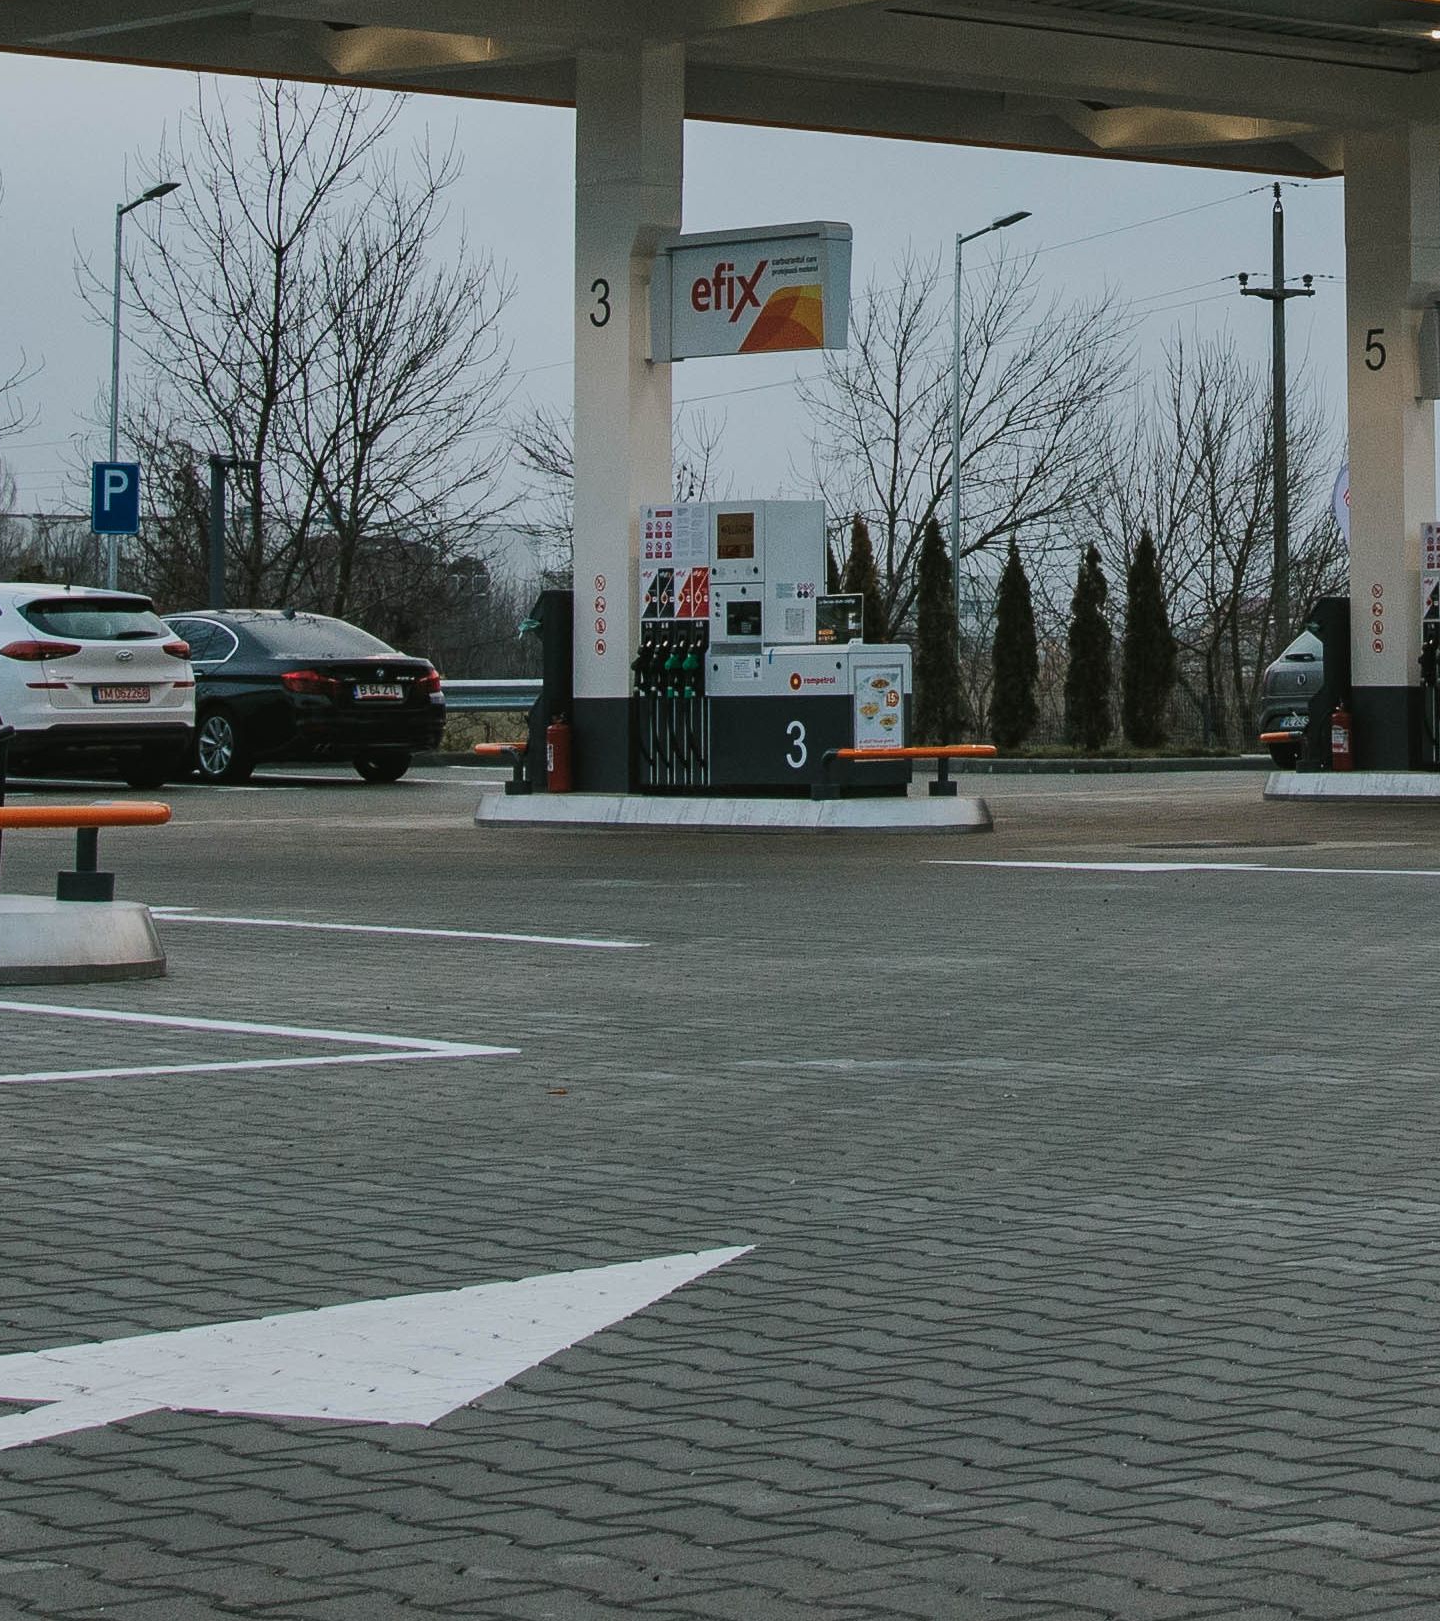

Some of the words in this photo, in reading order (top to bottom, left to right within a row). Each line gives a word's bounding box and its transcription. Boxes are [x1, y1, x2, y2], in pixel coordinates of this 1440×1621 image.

[589, 278, 610, 327] 3
[690, 259, 769, 323] efix
[1365, 328, 1387, 371] 5
[103, 469, 129, 511] P
[803, 676, 836, 686] rompetrol
[786, 720, 807, 768] 3
